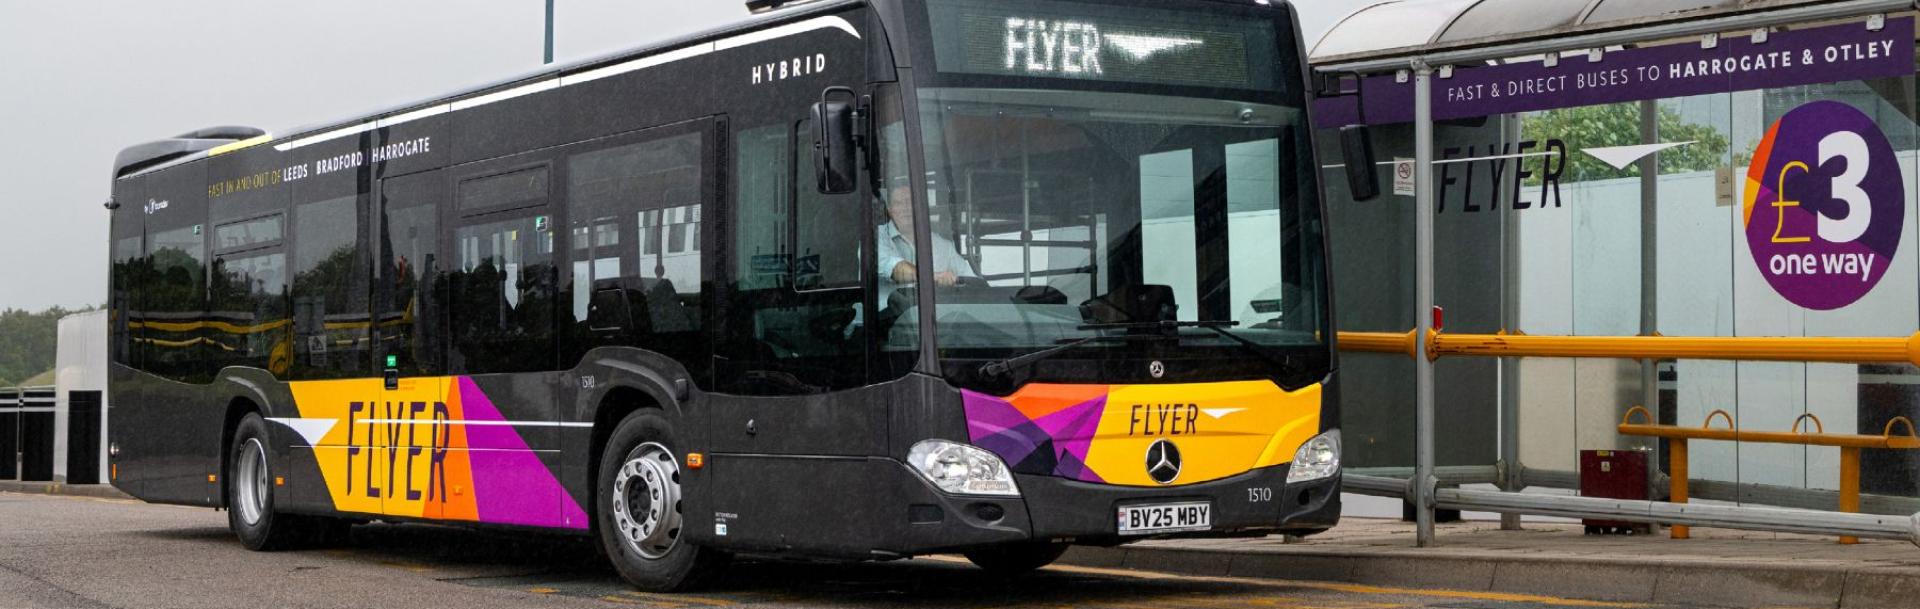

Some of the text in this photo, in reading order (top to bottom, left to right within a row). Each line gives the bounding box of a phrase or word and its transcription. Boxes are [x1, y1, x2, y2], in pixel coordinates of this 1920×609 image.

[1005, 17, 1102, 74] FLYER
[752, 53, 825, 85] HYBRID
[1448, 39, 1894, 102] FAST & DIRECT BUSES TO HARROGATE & OTLEY
[208, 182, 224, 199] FAST
[236, 176, 252, 192] AND
[253, 172, 269, 188] OUT
[271, 169, 281, 184] OF
[283, 163, 308, 182] LEEDS
[316, 151, 363, 175] BRADFORD
[372, 137, 431, 163] HARROGATE
[1438, 139, 1566, 213] FLYER
[1770, 253, 1875, 282] one way
[1129, 403, 1199, 436] FLYER
[347, 401, 450, 503] FLYER
[1130, 505, 1208, 528] BV25 MBY
[1248, 487, 1272, 502] 1510
